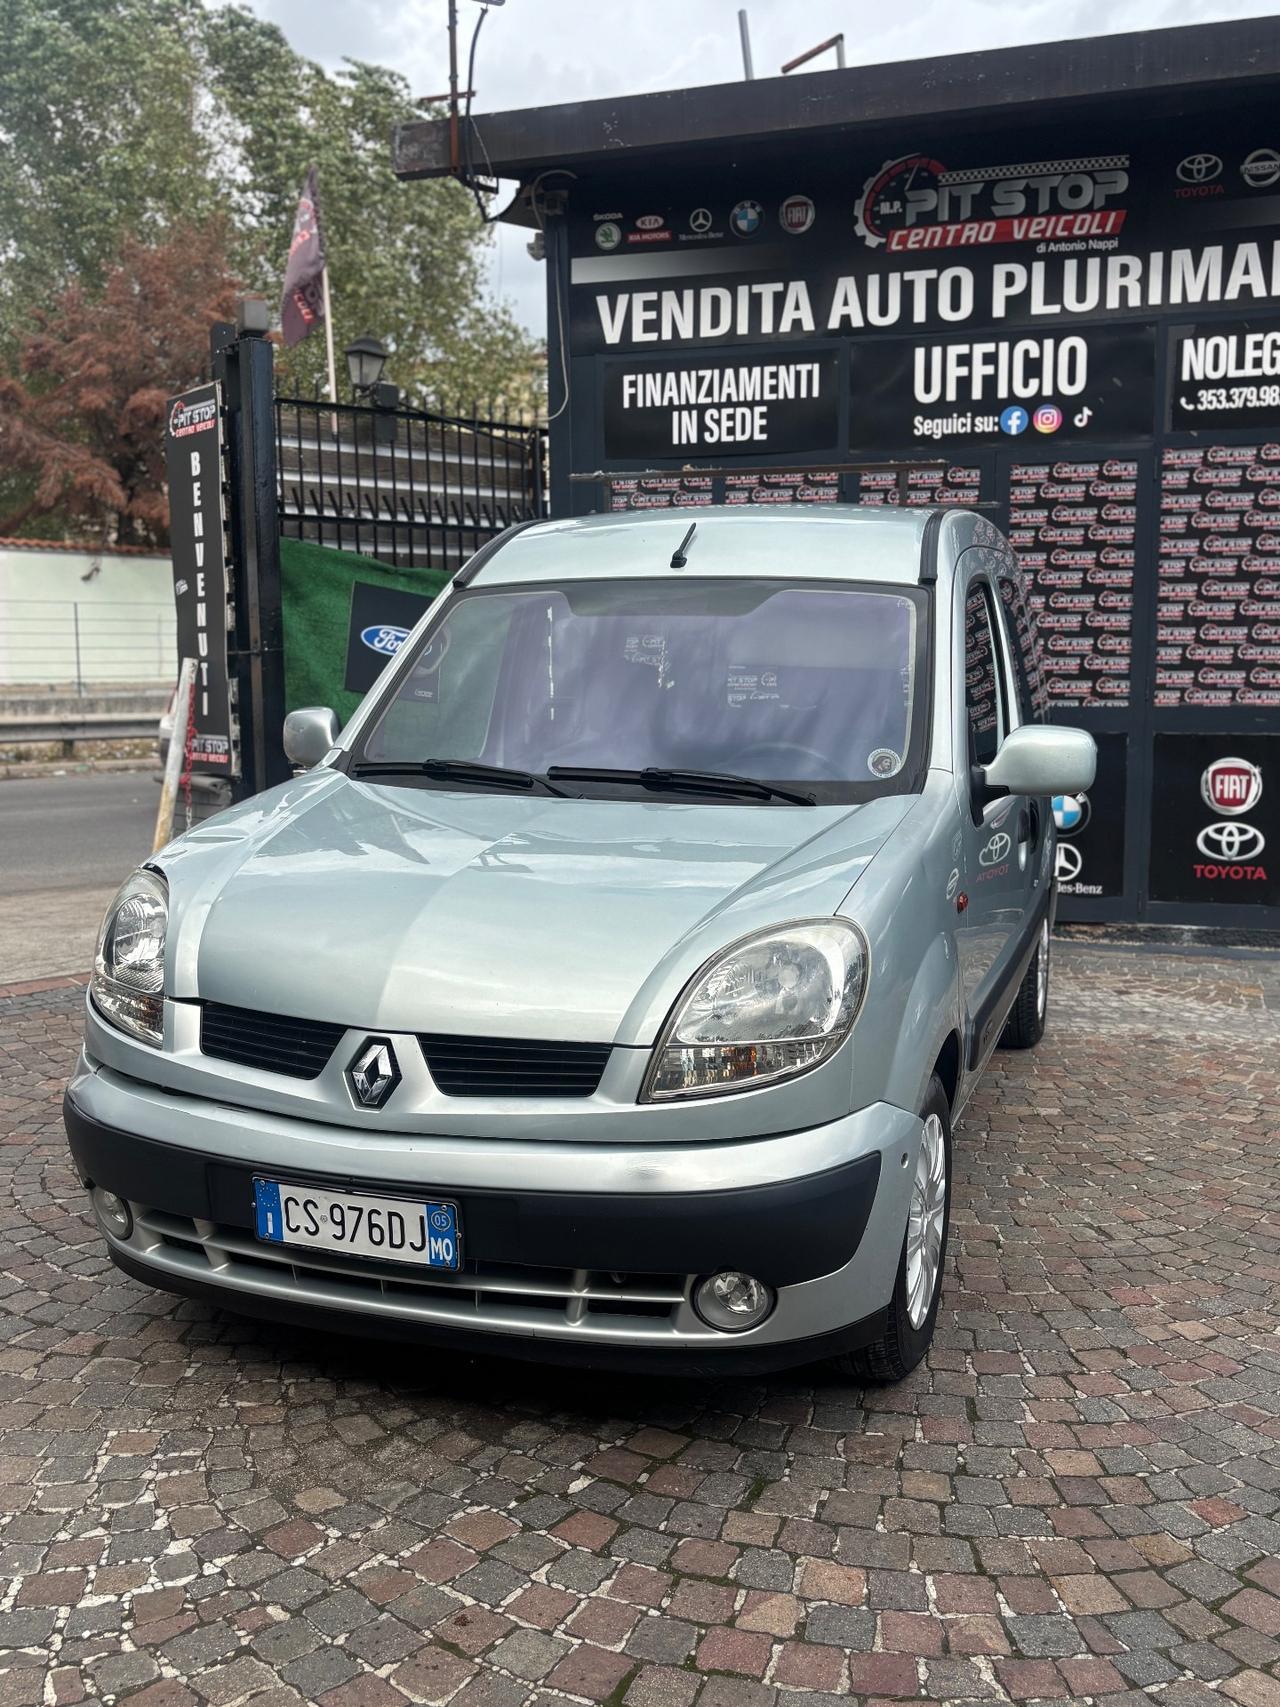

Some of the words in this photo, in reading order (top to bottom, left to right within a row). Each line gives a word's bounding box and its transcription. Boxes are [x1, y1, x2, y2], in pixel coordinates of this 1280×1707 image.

[905, 182, 985, 227] PIT
[990, 170, 1129, 217] STOP
[1174, 184, 1225, 199] TOYOTA
[787, 206, 807, 223] FIAT
[880, 201, 902, 215] M.P.
[640, 218, 660, 226] KIA
[890, 221, 996, 250] CENTRO
[1013, 211, 1117, 240] VEICOLI
[628, 233, 640, 241] KIA
[641, 231, 670, 240] MOTORS
[1036, 242, 1046, 253] di
[1048, 240, 1086, 252] Antonio
[1088, 237, 1118, 251] Nappi
[596, 280, 815, 344] VENDITA
[827, 266, 974, 330] AUTO
[992, 240, 1280, 318] PLURIMA
[914, 335, 1087, 404] UFFICIO
[622, 363, 819, 409] FINANZIAMENTI
[1197, 385, 1280, 410] 353.379.98
[178, 411, 191, 427] PIT
[192, 404, 216, 423] STOP
[672, 409, 698, 445] IN
[704, 405, 767, 442] SEDE
[913, 412, 971, 439] Seguici
[974, 415, 999, 433] su:
[190, 451, 208, 716] BENVENUTI
[205, 739, 229, 753] STOP
[1215, 774, 1250, 799] FIAT
[1193, 864, 1267, 880] TOYOTA
[433, 1213, 447, 1228] 05
[430, 1236, 453, 1261] MO
